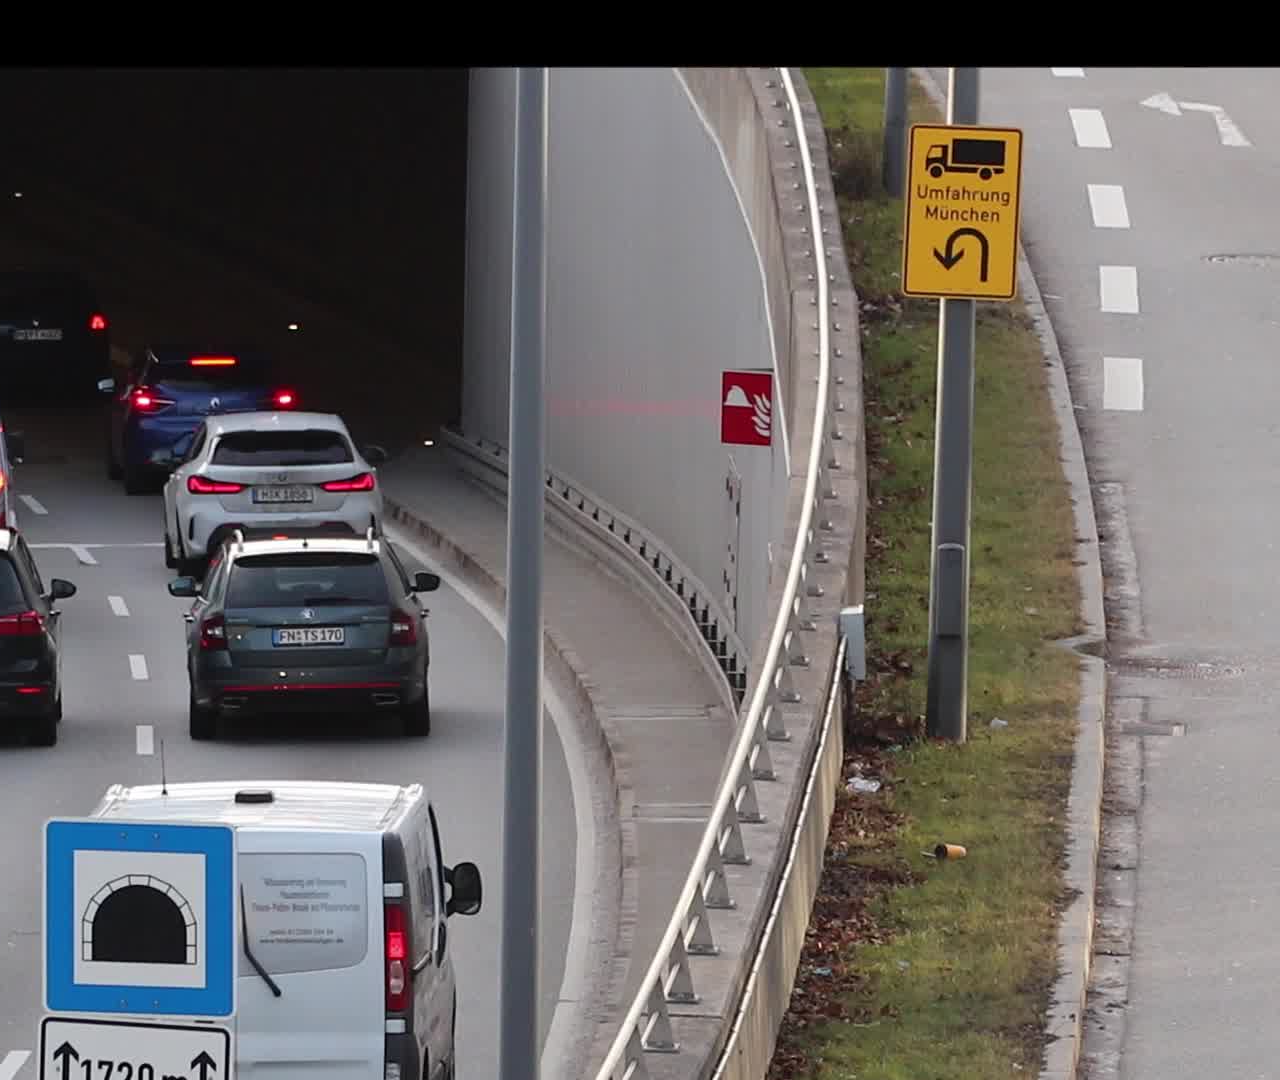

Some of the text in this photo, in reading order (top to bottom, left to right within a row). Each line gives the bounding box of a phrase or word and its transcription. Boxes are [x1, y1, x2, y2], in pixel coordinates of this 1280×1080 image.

[917, 184, 1011, 206] Umfahrung
[925, 205, 1000, 223] München
[279, 628, 342, 642] FN TS 170
